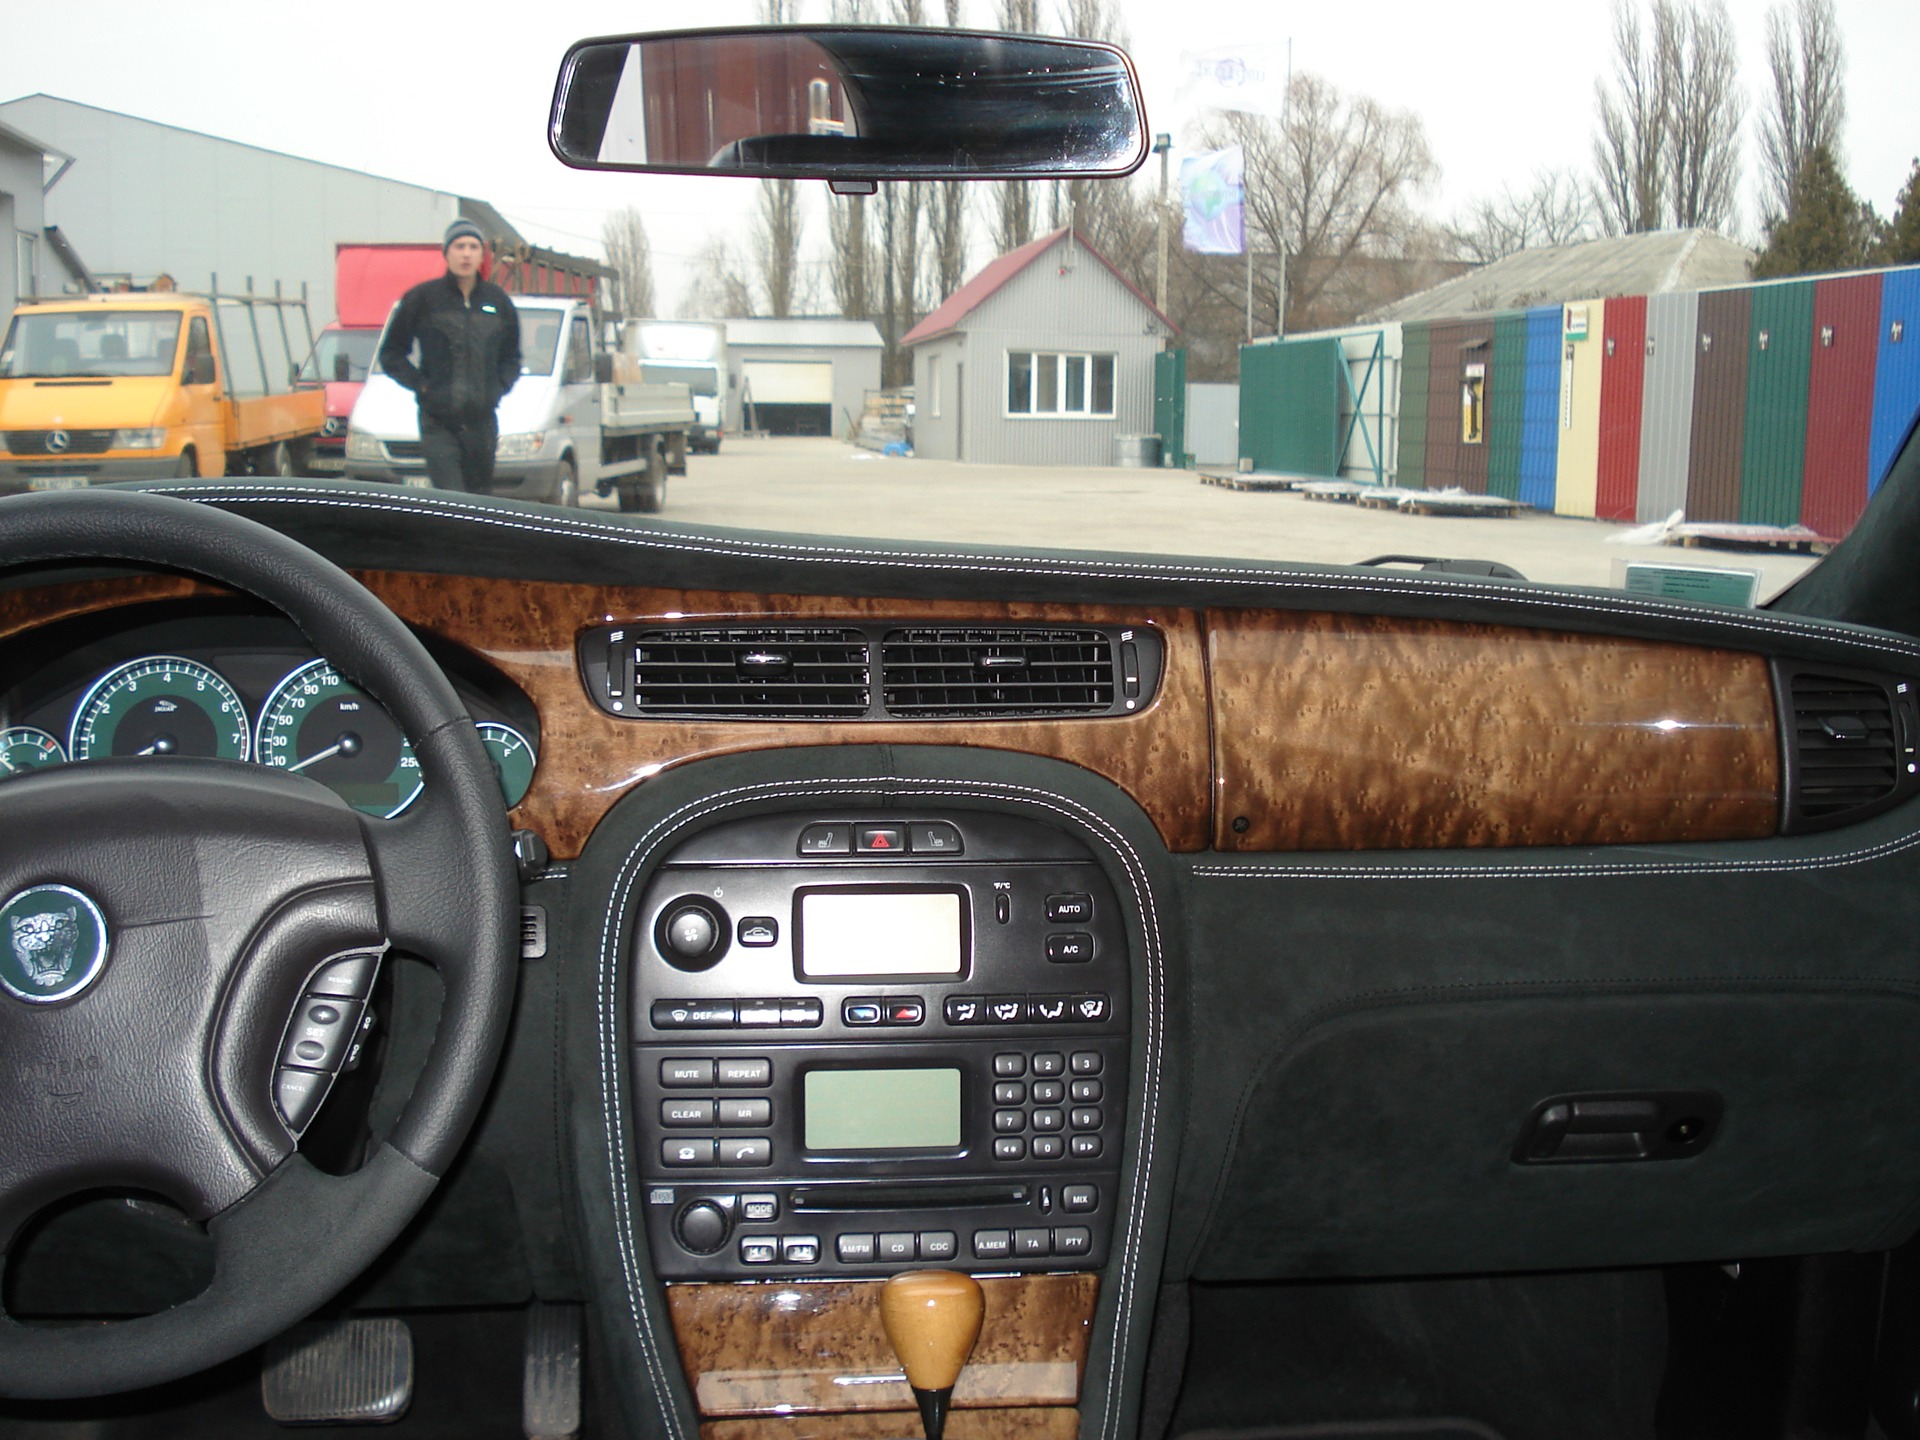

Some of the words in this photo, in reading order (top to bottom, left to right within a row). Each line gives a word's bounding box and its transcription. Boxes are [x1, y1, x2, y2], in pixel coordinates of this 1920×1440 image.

[163, 673, 171, 683] 4
[321, 675, 339, 686] 110
[129, 681, 137, 692] 3
[197, 681, 205, 691] 5
[304, 685, 319, 695] 90
[221, 702, 229, 713] 6
[291, 698, 305, 708] 70
[339, 702, 360, 711] km/h
[102, 703, 110, 714] 2
[278, 715, 293, 725] 50
[90, 734, 96, 744] 1
[232, 734, 240, 744] 7
[272, 736, 287, 746] 30
[2, 752, 11, 762] C
[39, 752, 48, 761] H
[504, 748, 511, 758] F
[274, 756, 286, 766] 10
[1058, 905, 1081, 913] AUTO
[1063, 945, 1079, 954] A/C
[363, 1017, 371, 1029] ON
[306, 1028, 325, 1037] SET
[1007, 1061, 1013, 1070] 1
[1045, 1061, 1052, 1070] 2
[1083, 1059, 1090, 1069] 3
[675, 1070, 699, 1079] MUTE
[727, 1069, 761, 1078] REPEAT
[281, 1084, 307, 1092] CANCEL
[1045, 1088, 1052, 1098] 5
[1083, 1087, 1089, 1096] 6
[1006, 1089, 1013, 1099] 4
[671, 1110, 702, 1119] CLEAR
[737, 1110, 752, 1118] MR
[1006, 1117, 1013, 1127] 7
[1044, 1116, 1051, 1125] 8
[1083, 1115, 1090, 1124] 9
[1044, 1144, 1051, 1152] 0
[1072, 1196, 1088, 1204] MIX
[746, 1204, 773, 1214] MODE
[929, 1242, 949, 1251] CDC
[978, 1240, 1006, 1250] A.MEM
[1027, 1239, 1039, 1248] TA
[1065, 1238, 1083, 1247] PTY
[842, 1244, 870, 1254] AM/FM
[891, 1244, 904, 1253] CD
